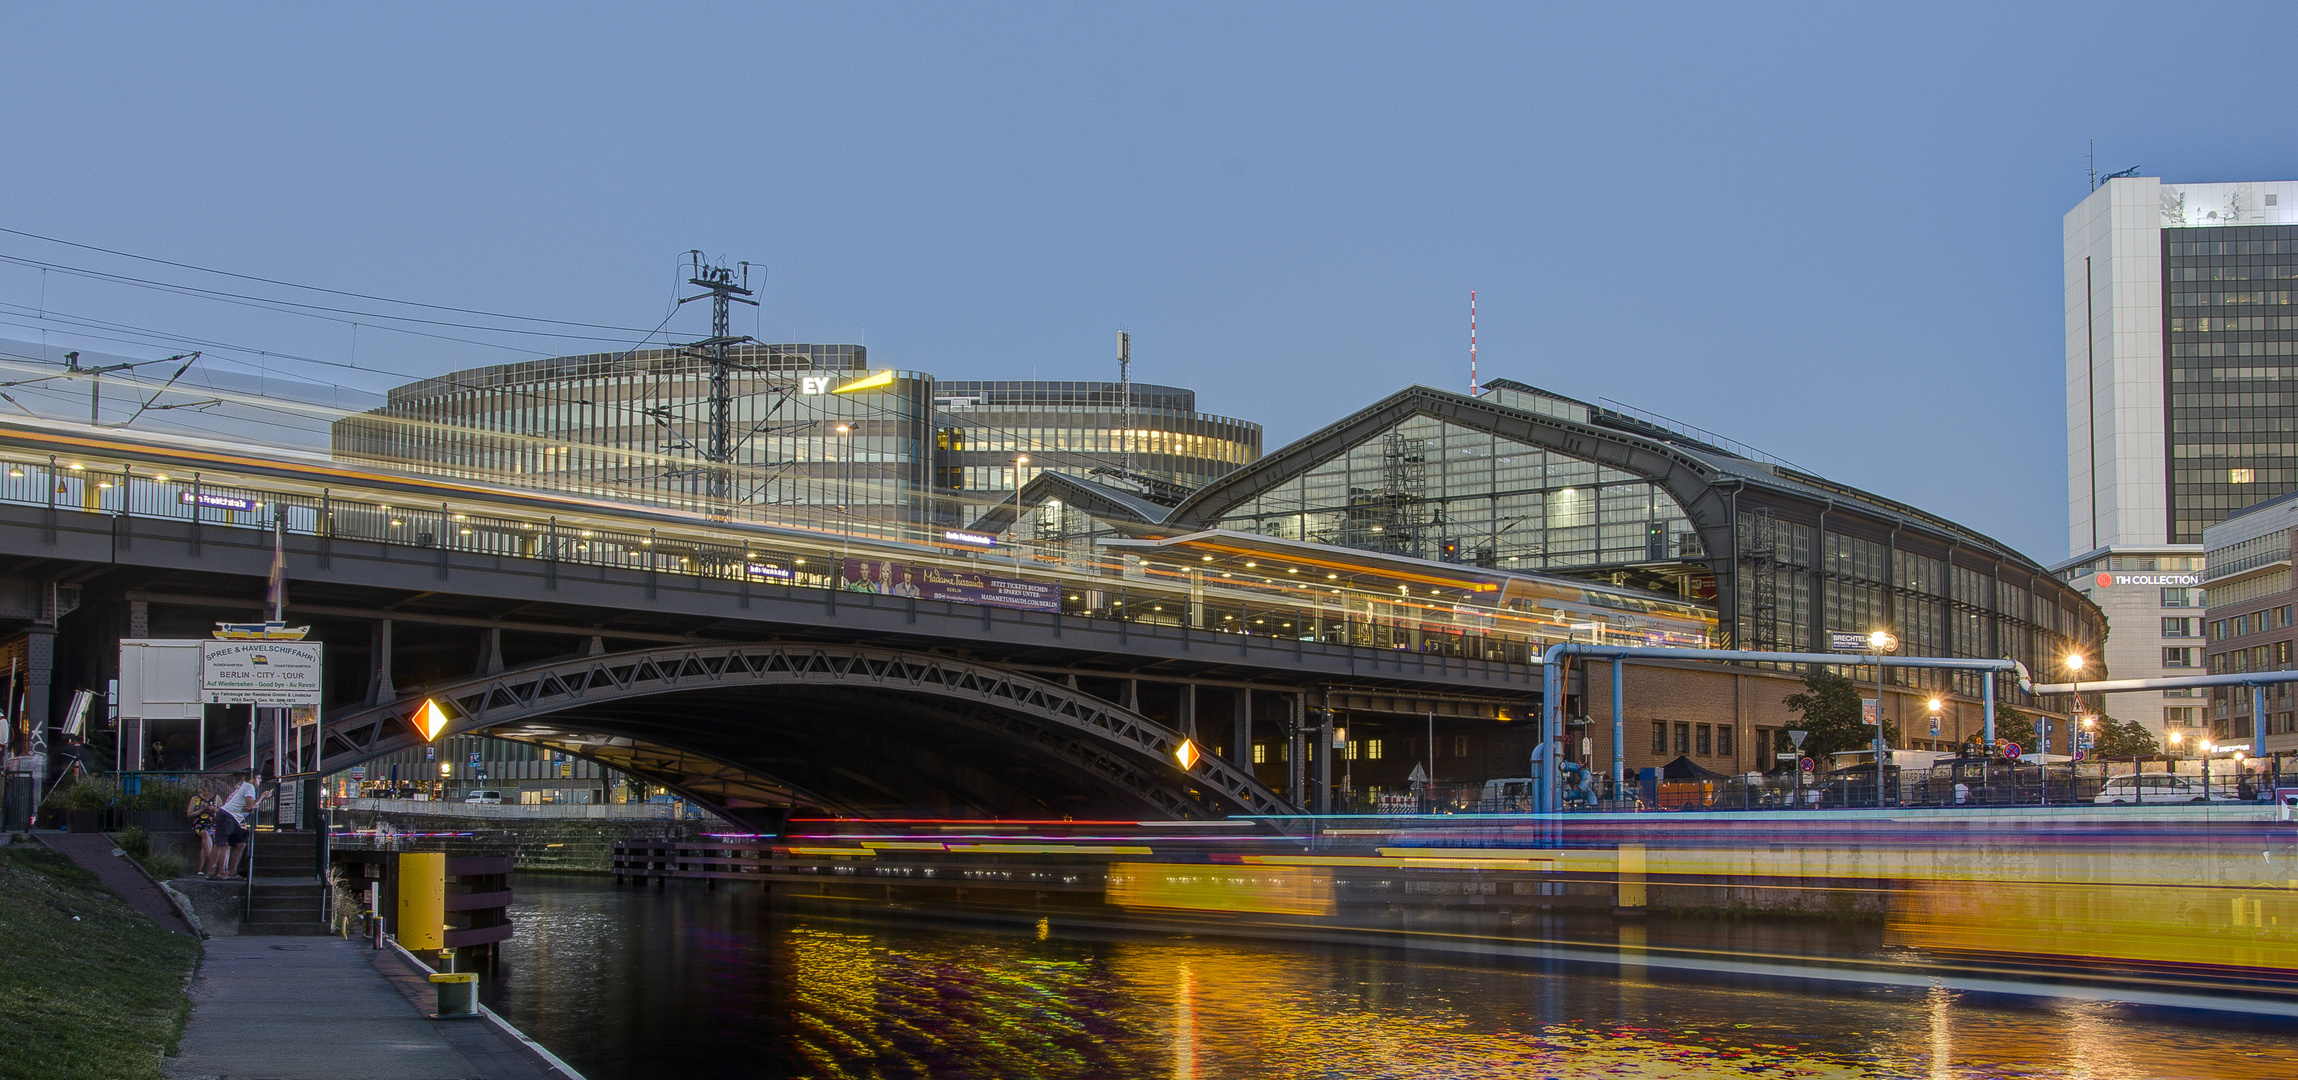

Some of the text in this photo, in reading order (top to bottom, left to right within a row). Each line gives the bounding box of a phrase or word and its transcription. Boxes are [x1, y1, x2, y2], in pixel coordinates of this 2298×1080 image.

[803, 377, 829, 394] EY
[923, 568, 984, 589] Madame Tussauds
[2132, 575, 2199, 585] COLLECTION
[990, 580, 1049, 593] JETZT TICKETS BUCHEN
[1003, 588, 1023, 596] SPAREN
[1833, 634, 1866, 642] BRECHTEL
[206, 647, 233, 661] SPREE
[256, 671, 275, 679] CITY
[282, 672, 304, 680] TOUR
